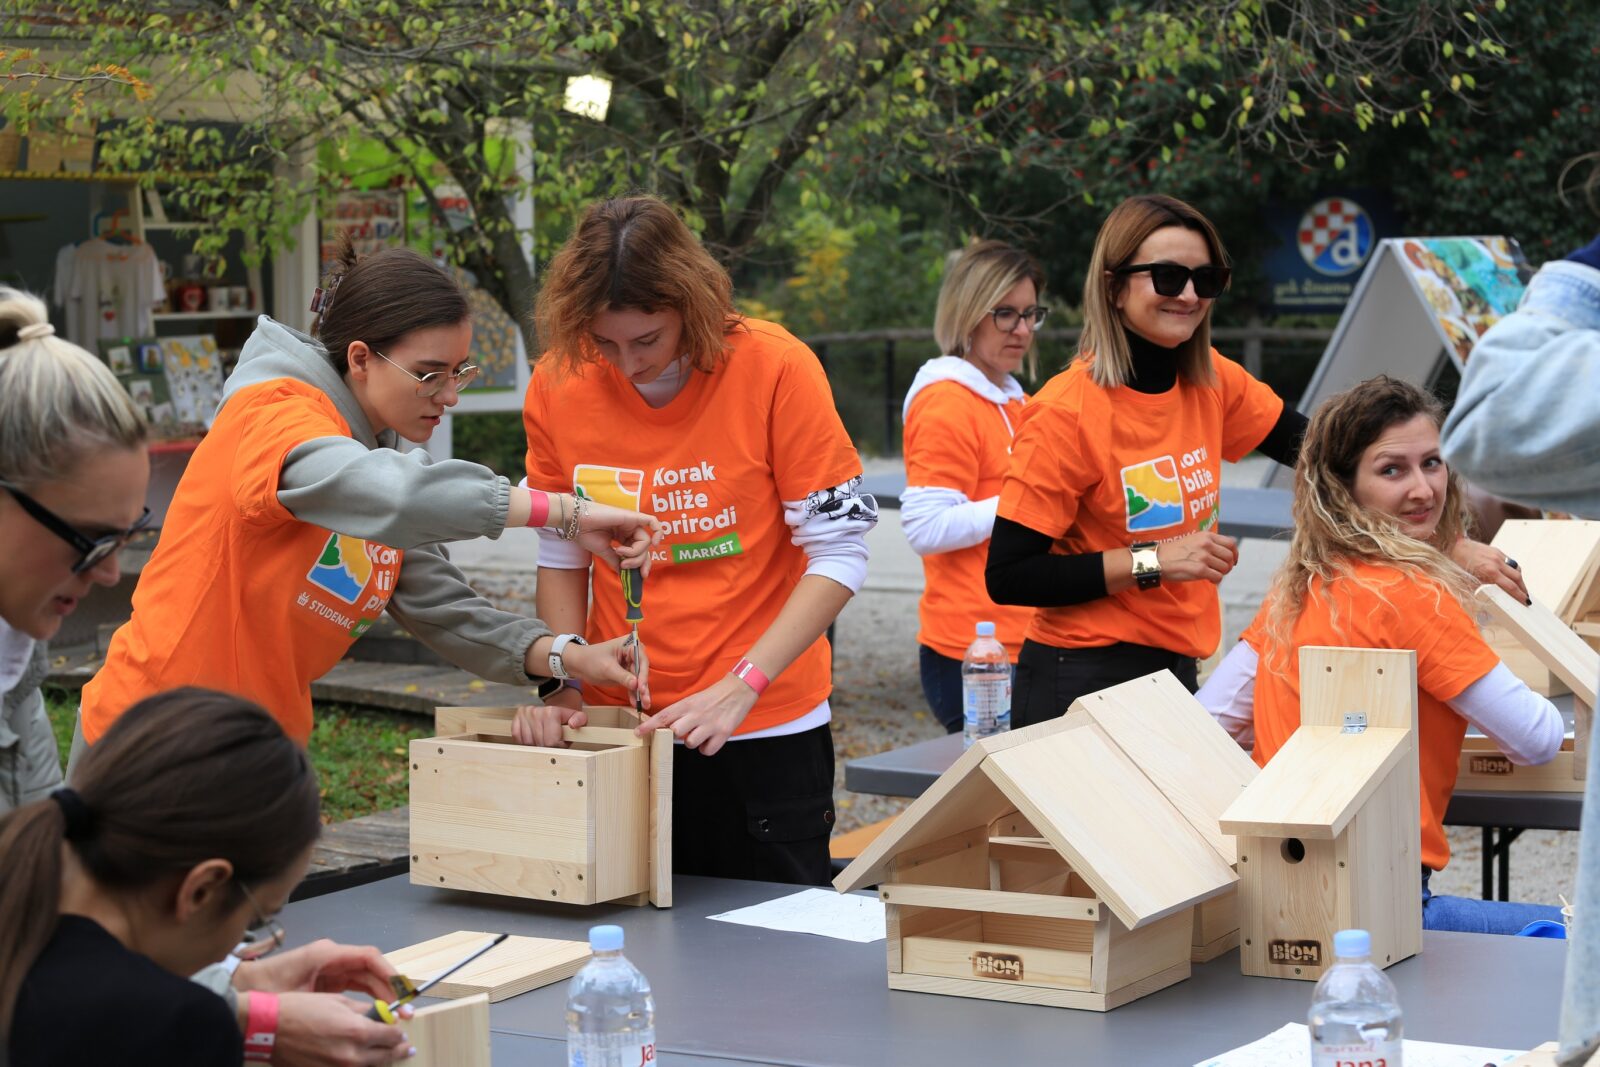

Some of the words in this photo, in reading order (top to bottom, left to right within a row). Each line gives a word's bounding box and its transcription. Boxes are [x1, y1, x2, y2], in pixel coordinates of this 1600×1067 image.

[652, 460, 717, 487] Korak
[651, 488, 708, 513] bliže
[678, 540, 734, 561] MARKET
[309, 600, 355, 630] STUDENAC
